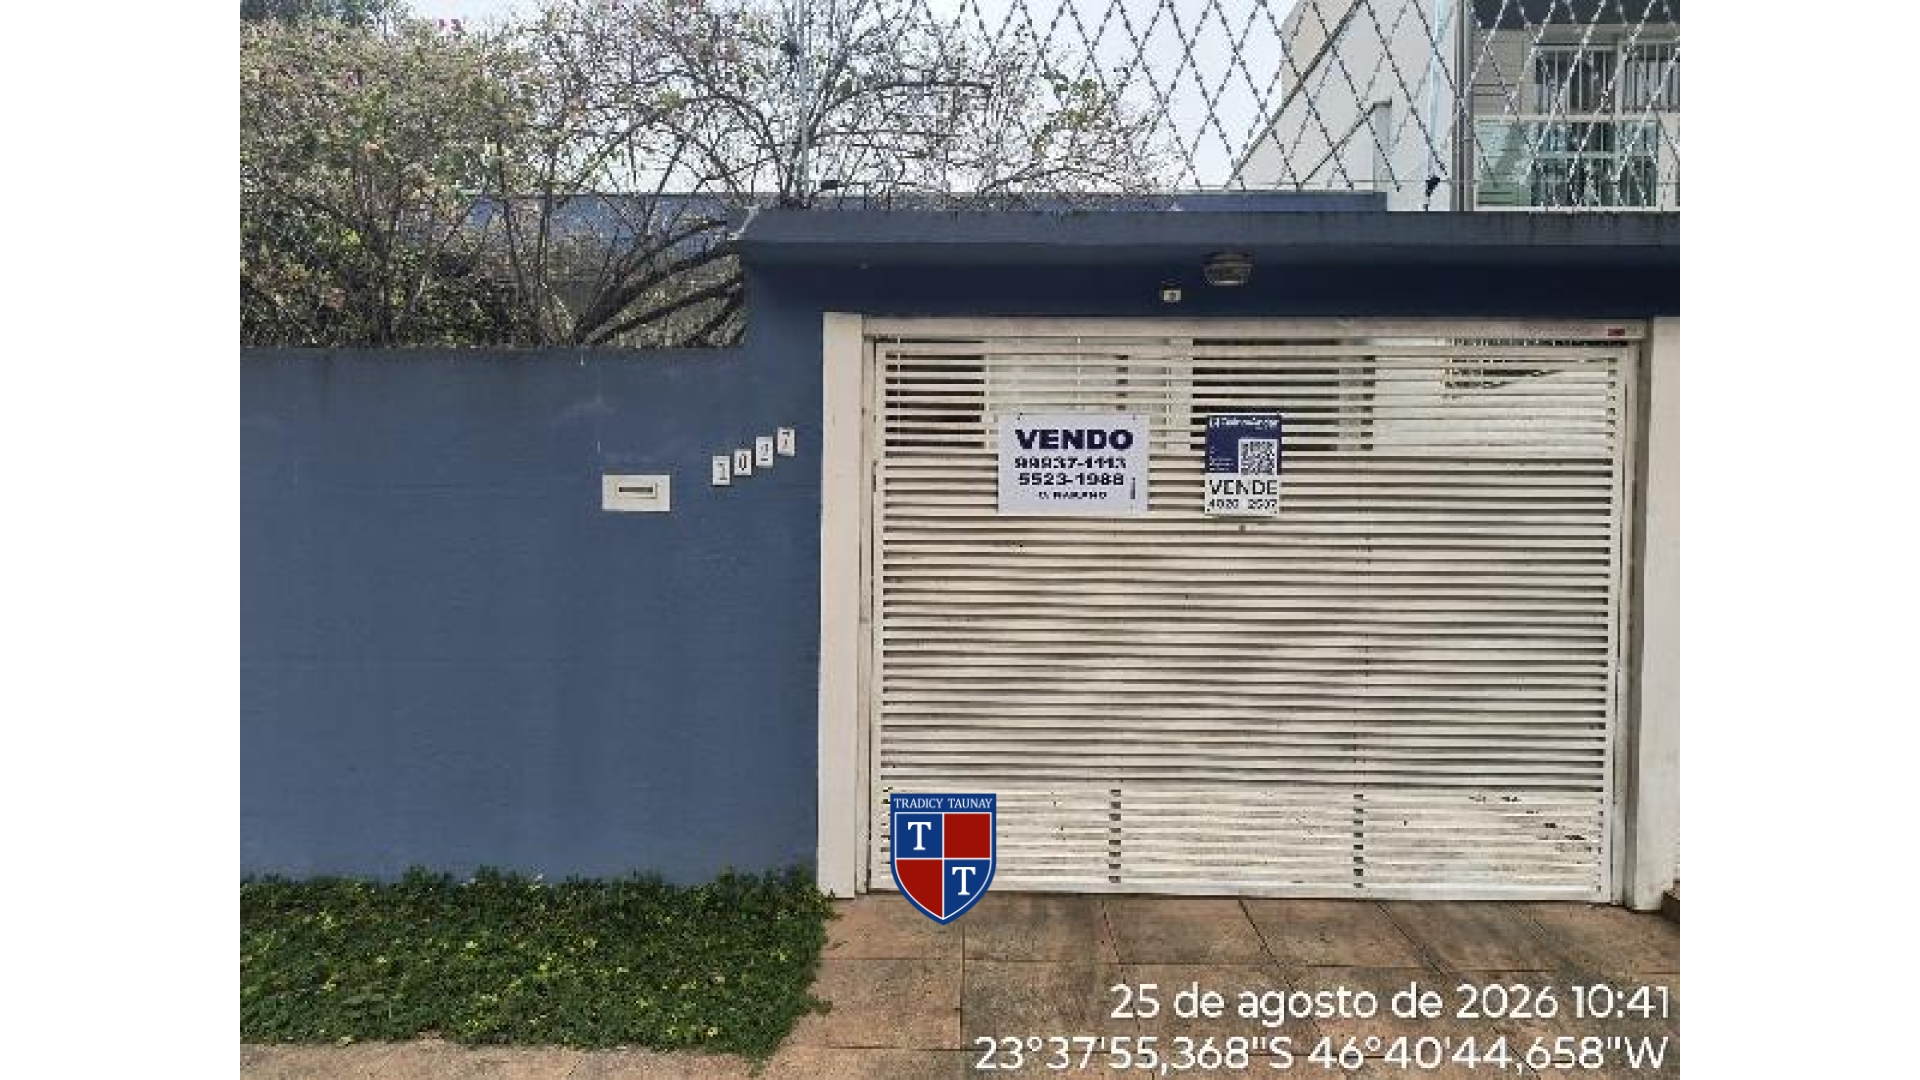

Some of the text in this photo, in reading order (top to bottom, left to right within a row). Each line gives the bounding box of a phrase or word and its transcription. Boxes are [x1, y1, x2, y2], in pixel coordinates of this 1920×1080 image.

[1015, 429, 1134, 450] VENDO
[1018, 473, 1124, 486] 5523-1988
[1209, 480, 1278, 495] VENDE
